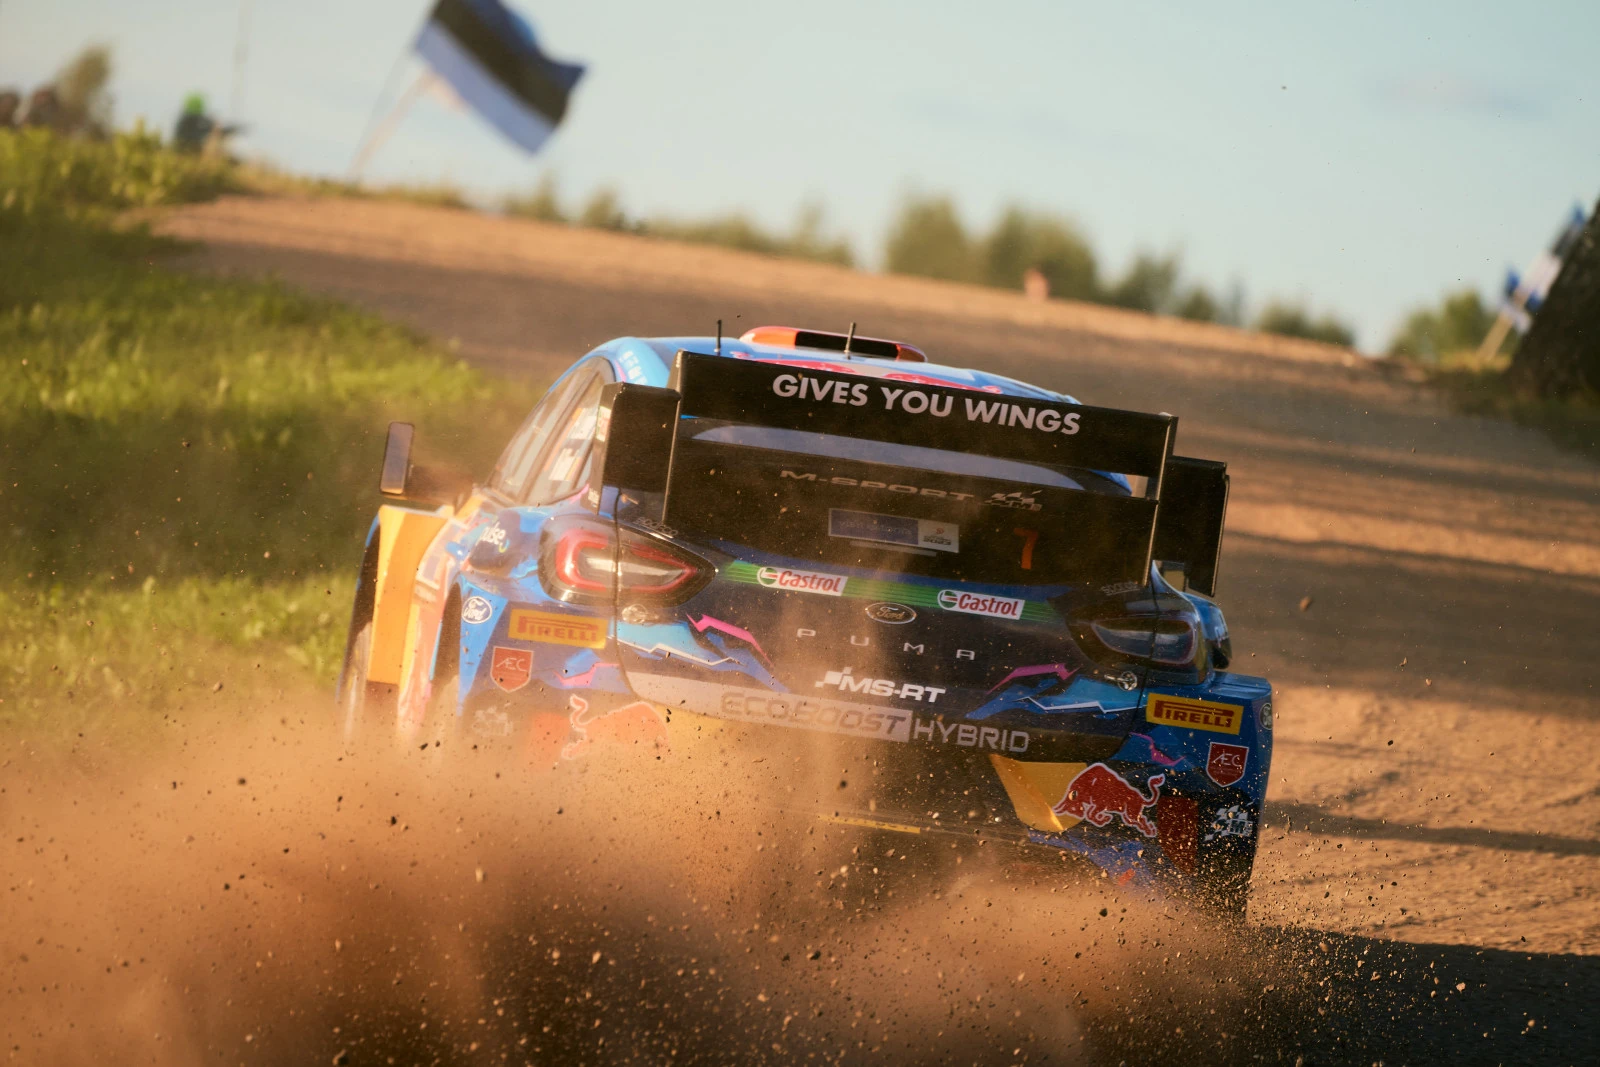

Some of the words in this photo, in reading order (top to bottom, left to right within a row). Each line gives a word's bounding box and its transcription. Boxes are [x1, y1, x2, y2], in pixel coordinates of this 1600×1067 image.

[772, 374, 868, 407] GIVES
[881, 387, 953, 417] YOU
[965, 398, 1080, 435] WINGS
[780, 470, 975, 502] M-SPORT
[1014, 527, 1039, 570] 7
[778, 569, 842, 594] Castrol
[957, 593, 1019, 616] Castrol
[517, 615, 600, 641] PIRELLI
[796, 627, 975, 661] PUMA
[720, 691, 907, 736] ECOBOOST
[913, 717, 1030, 753] HYBRID
[1153, 700, 1235, 728] PIRELLI
